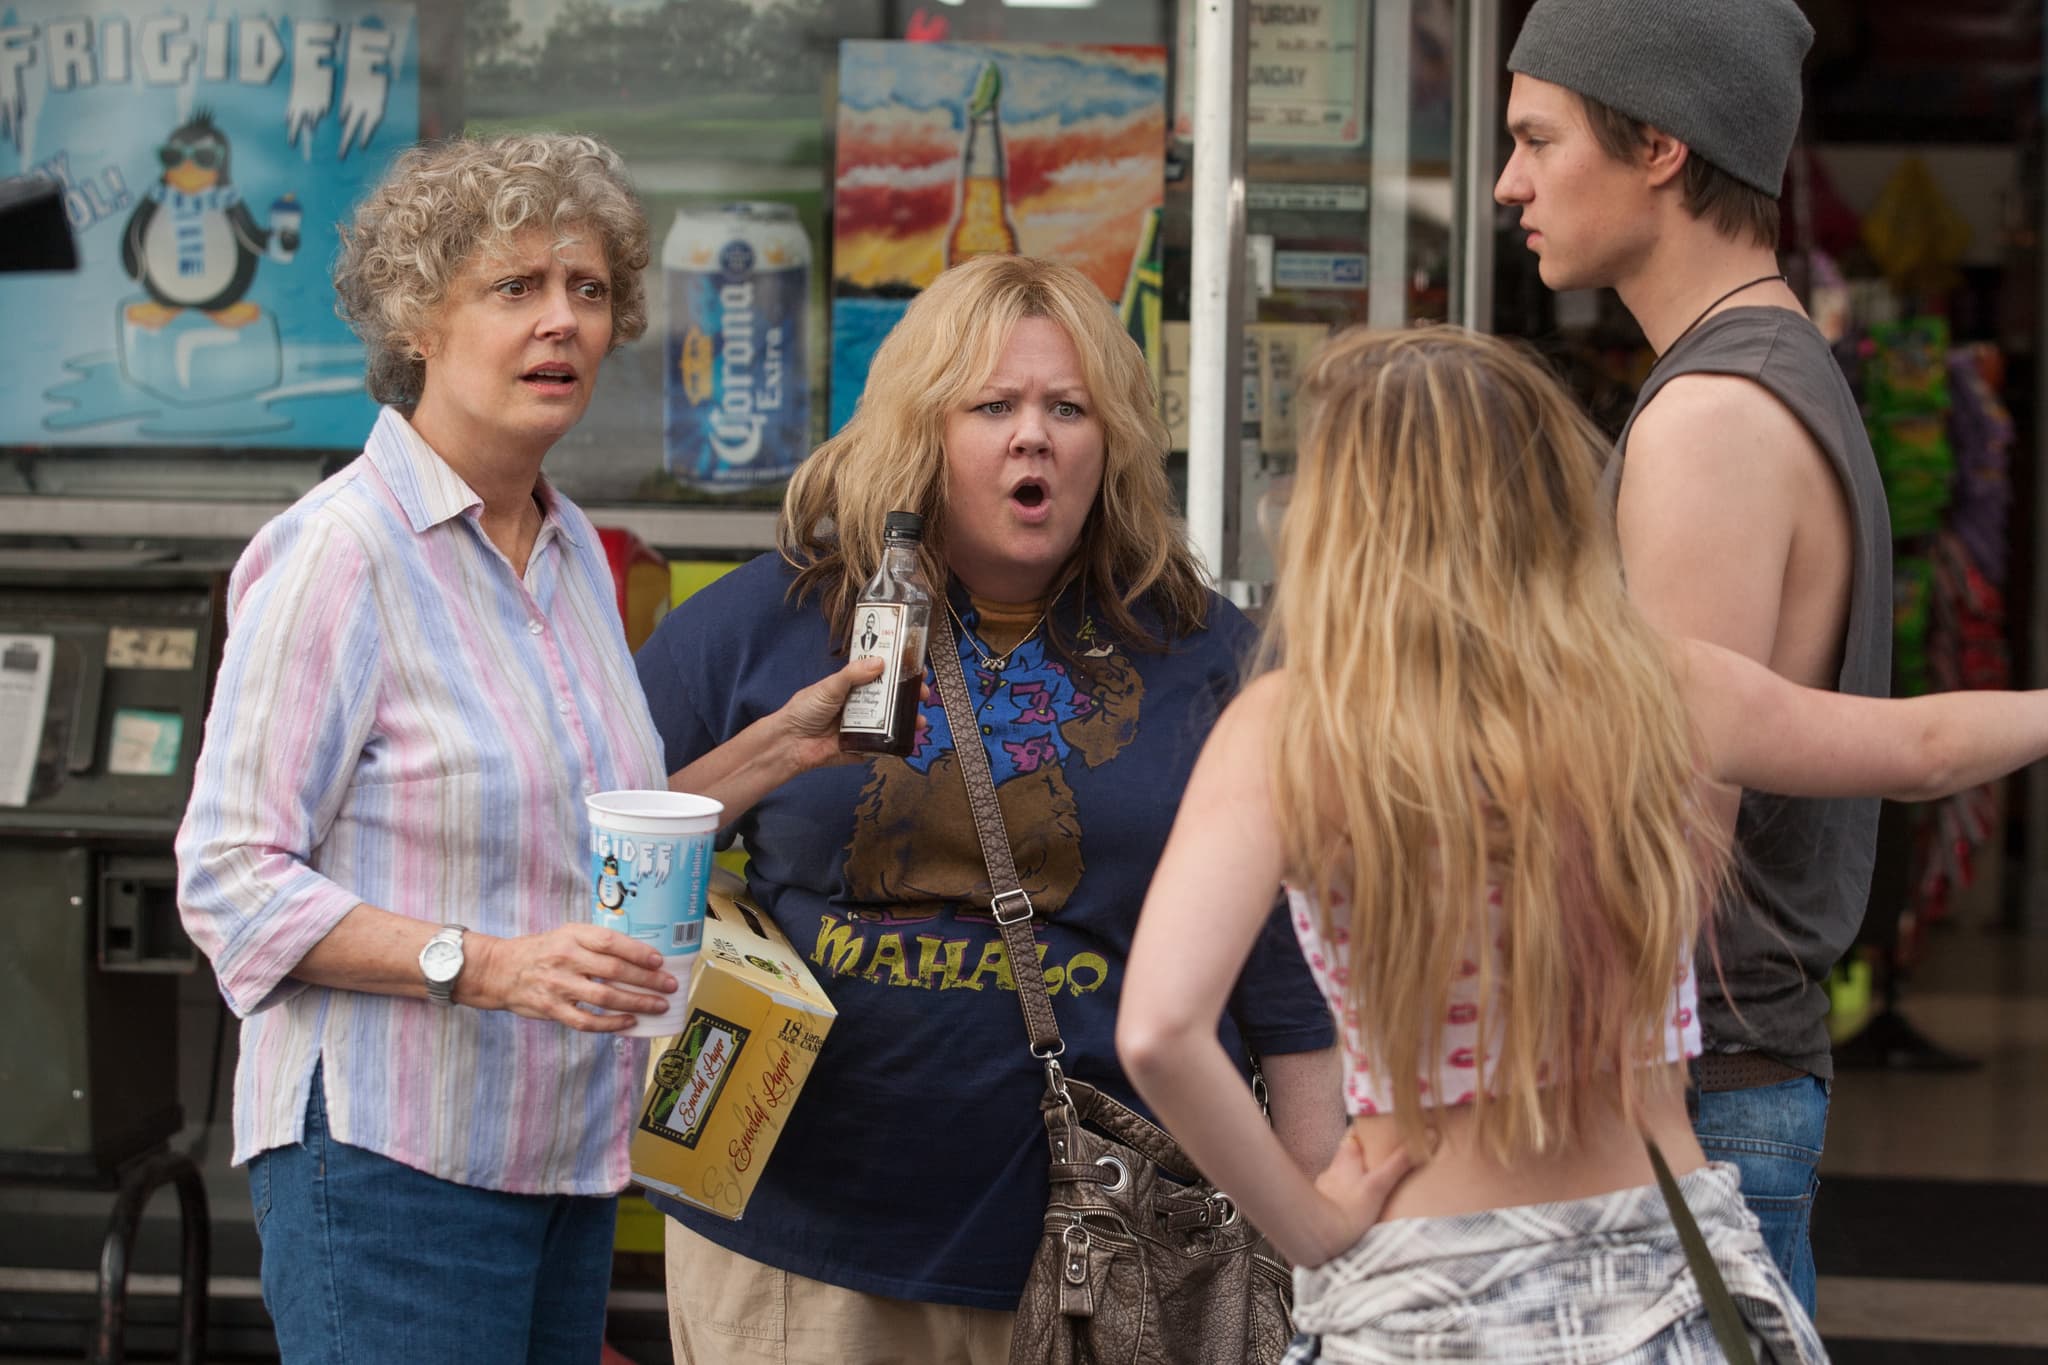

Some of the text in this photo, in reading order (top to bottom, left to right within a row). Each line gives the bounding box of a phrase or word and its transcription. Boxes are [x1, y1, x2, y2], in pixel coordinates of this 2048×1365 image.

[709, 282, 768, 465] Corona
[756, 326, 783, 410] Extra
[782, 1018, 803, 1038] 18
[703, 1038, 727, 1080] Lager
[762, 1050, 794, 1108] Lager
